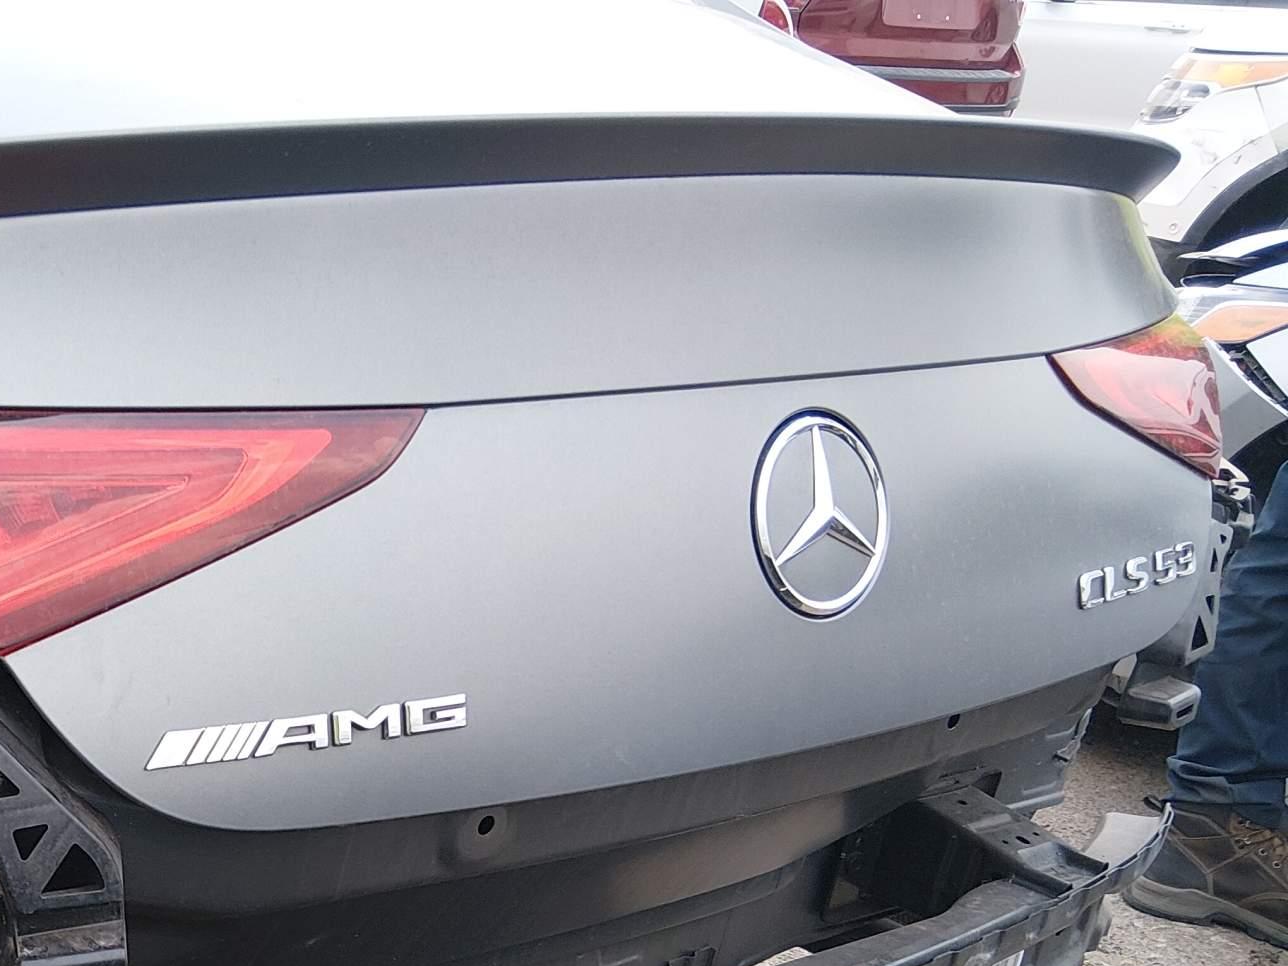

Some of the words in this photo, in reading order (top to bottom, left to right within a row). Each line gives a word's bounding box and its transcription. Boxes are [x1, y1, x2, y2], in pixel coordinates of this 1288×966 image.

[1079, 556, 1150, 610] CLS
[1153, 541, 1197, 585] 53
[251, 693, 468, 759] AMG
